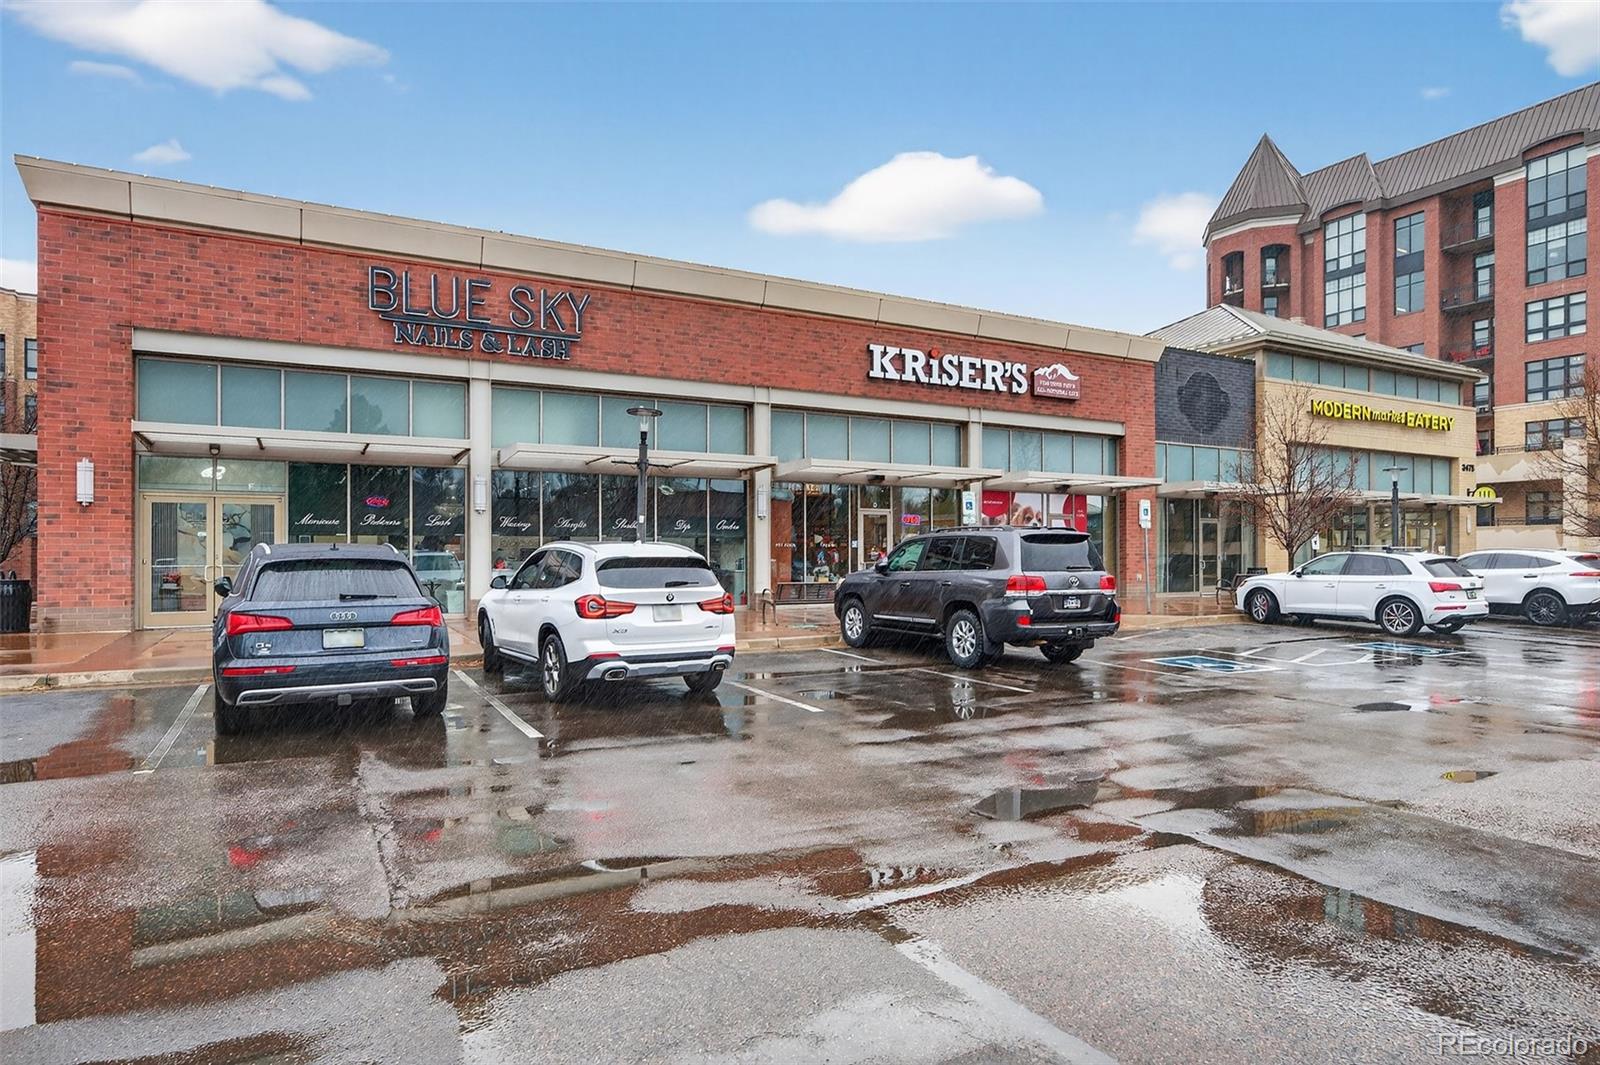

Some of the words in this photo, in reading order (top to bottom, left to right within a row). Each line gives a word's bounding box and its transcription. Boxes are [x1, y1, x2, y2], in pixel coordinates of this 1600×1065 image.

[368, 266, 491, 323] BLUE
[509, 284, 590, 333] SKY
[392, 321, 473, 350] NAILS
[480, 331, 504, 353] &
[507, 334, 571, 360] LASH
[1311, 399, 1371, 422] MODERN
[1371, 411, 1406, 424] market
[1406, 411, 1455, 432] EATERY
[425, 514, 451, 527] Lash
